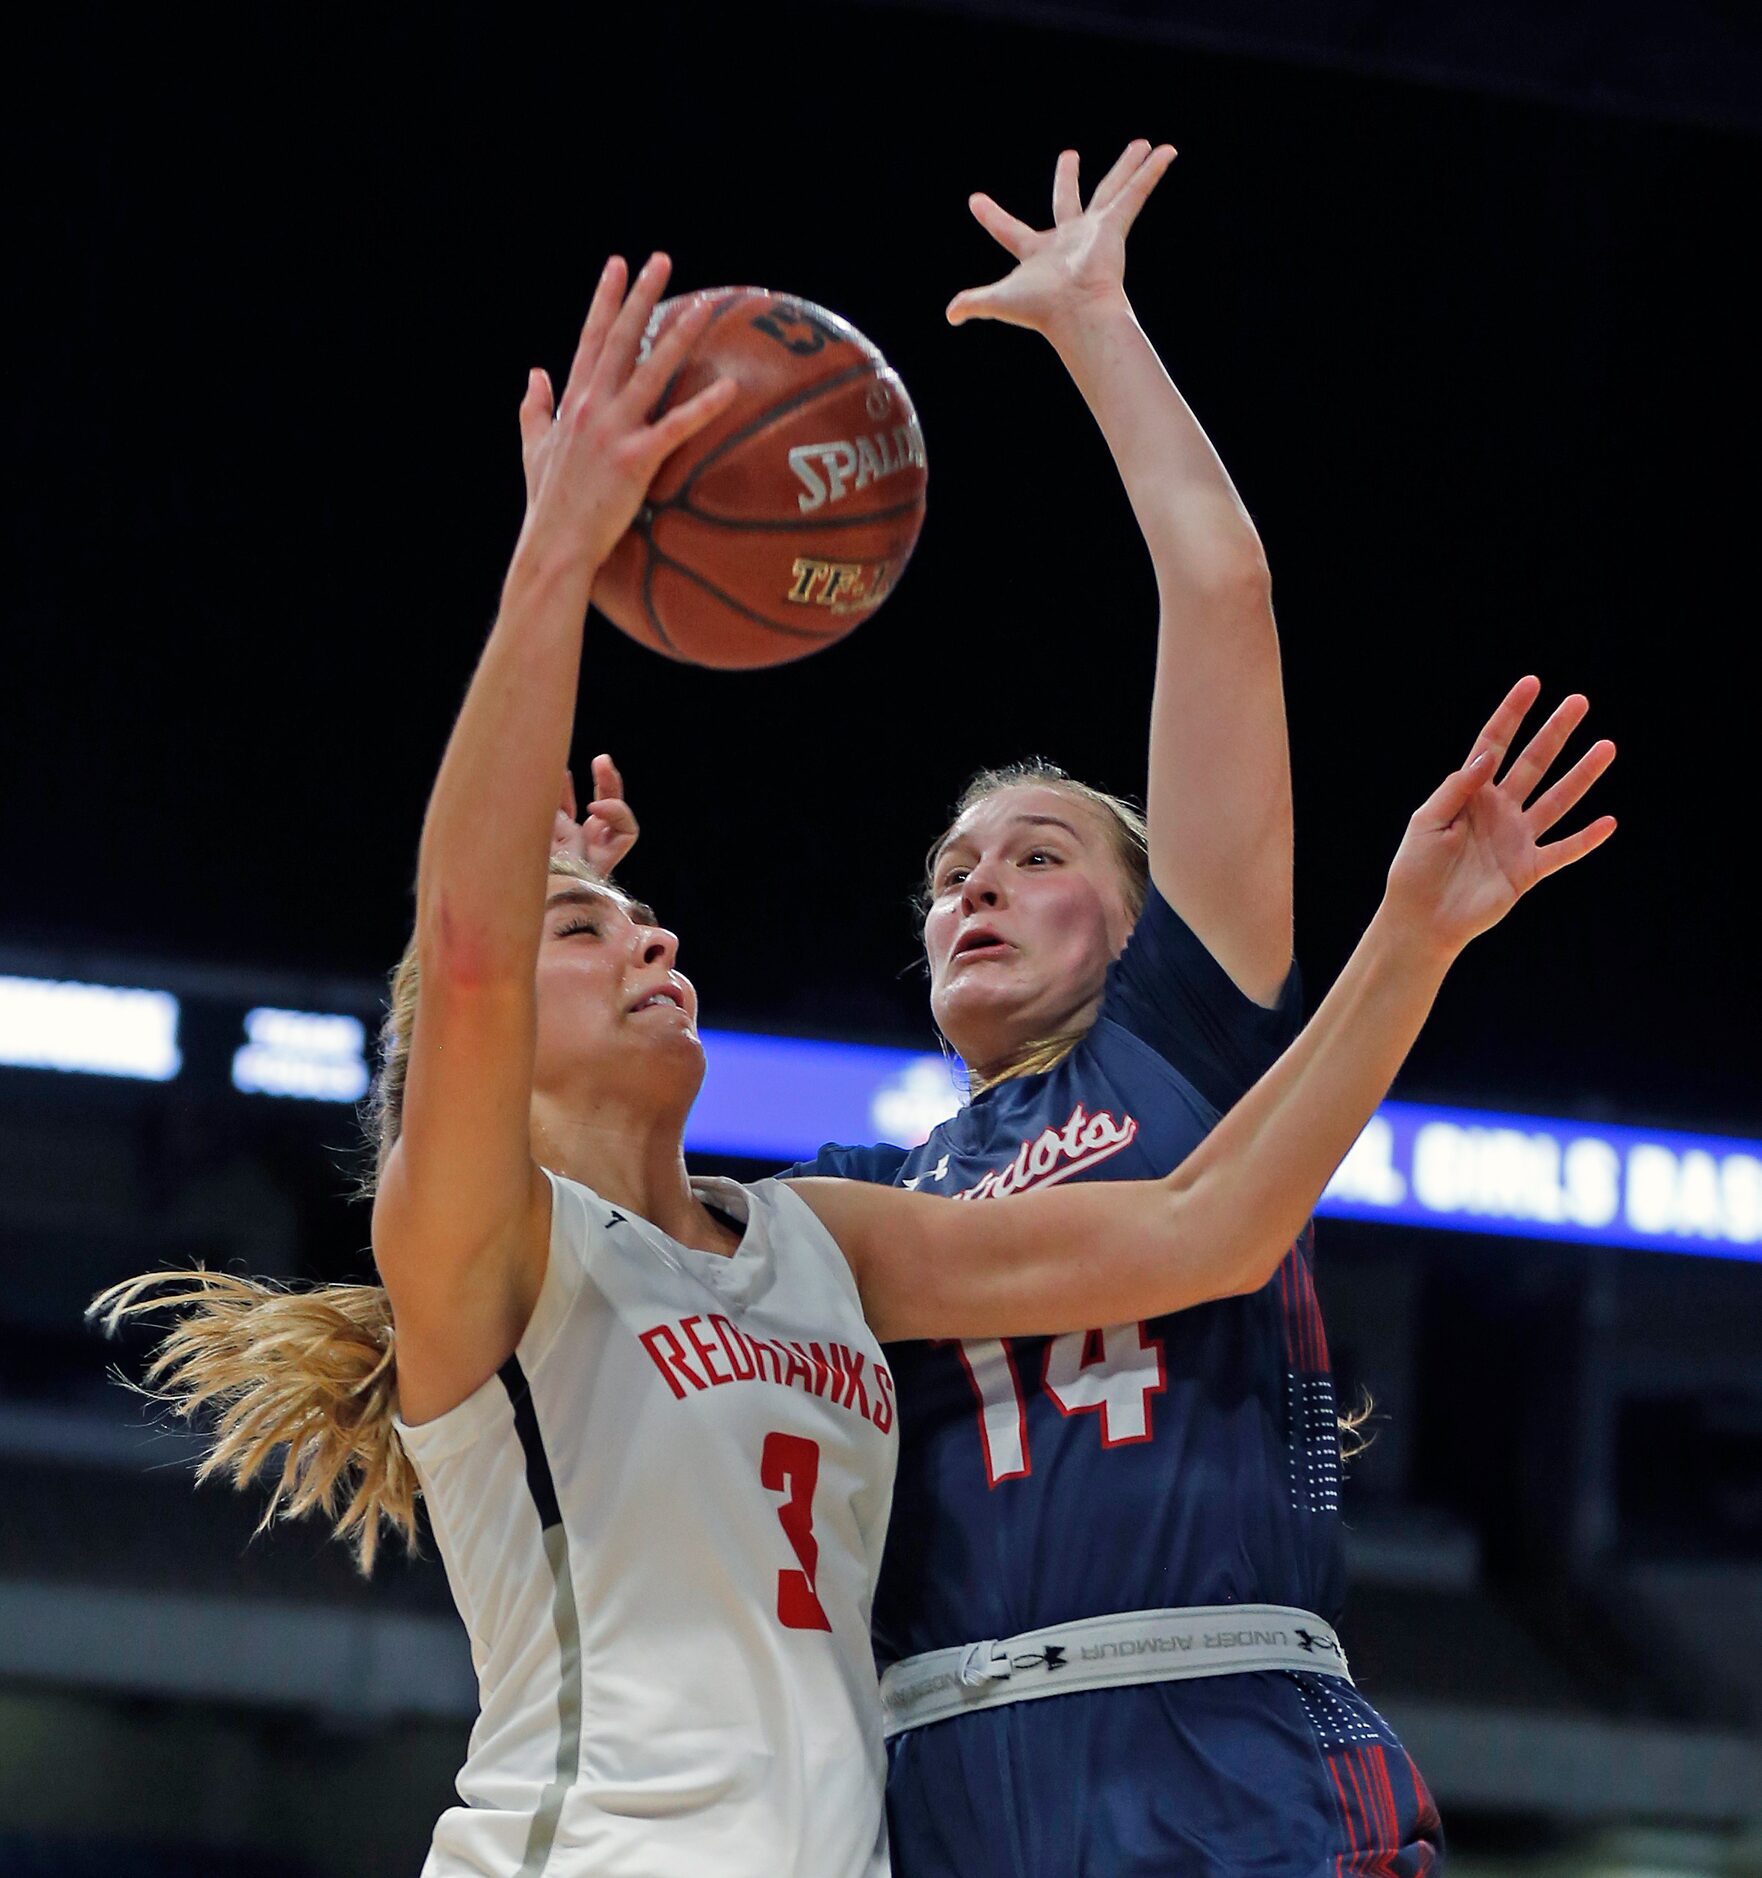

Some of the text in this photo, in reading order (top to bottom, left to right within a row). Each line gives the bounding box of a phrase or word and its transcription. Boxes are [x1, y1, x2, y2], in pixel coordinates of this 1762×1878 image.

[638, 1313, 893, 1435] REDHAWKS
[928, 1320, 1167, 1491] 14
[760, 1431, 832, 1633] 3
[1081, 1629, 1288, 1661] UNDER ARMOUR
